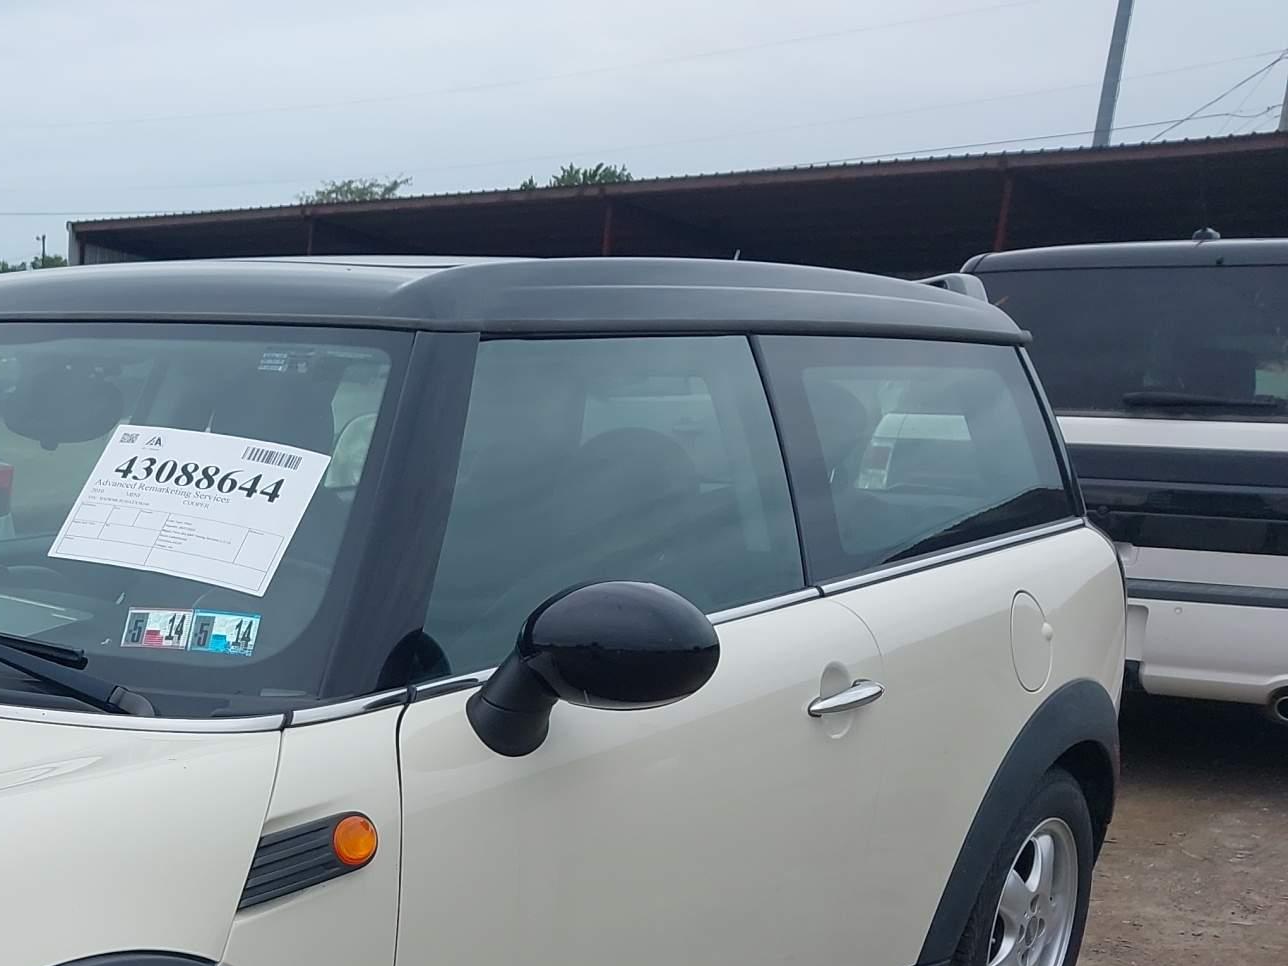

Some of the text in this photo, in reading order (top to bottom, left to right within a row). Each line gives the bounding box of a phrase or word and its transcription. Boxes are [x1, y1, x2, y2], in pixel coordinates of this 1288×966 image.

[95, 479, 231, 504] Advanced Remarketing Services
[114, 455, 287, 503] 43088644
[164, 613, 186, 641] 14
[231, 618, 253, 647] 14
